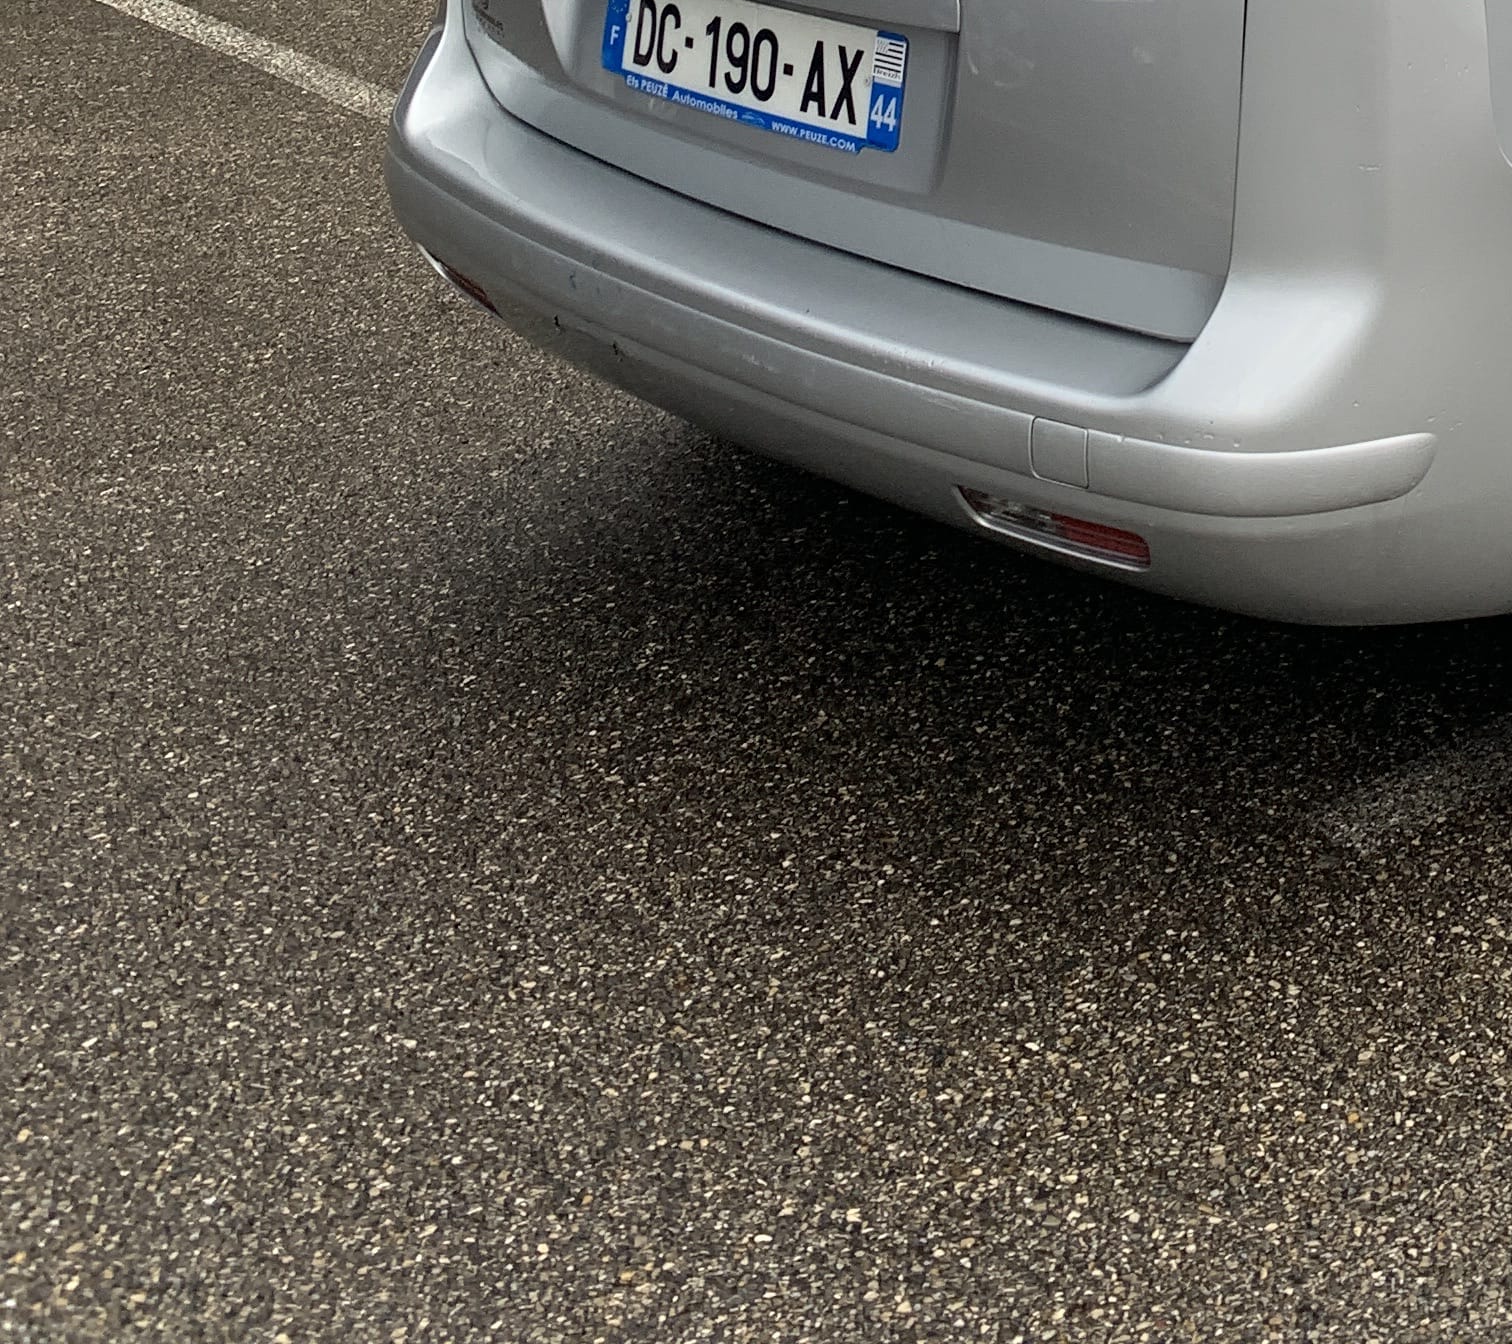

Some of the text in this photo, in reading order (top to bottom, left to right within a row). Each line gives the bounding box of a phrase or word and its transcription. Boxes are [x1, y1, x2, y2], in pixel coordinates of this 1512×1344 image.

[609, 25, 620, 47] F
[671, 90, 738, 120] Automobiles
[870, 94, 897, 132] 44
